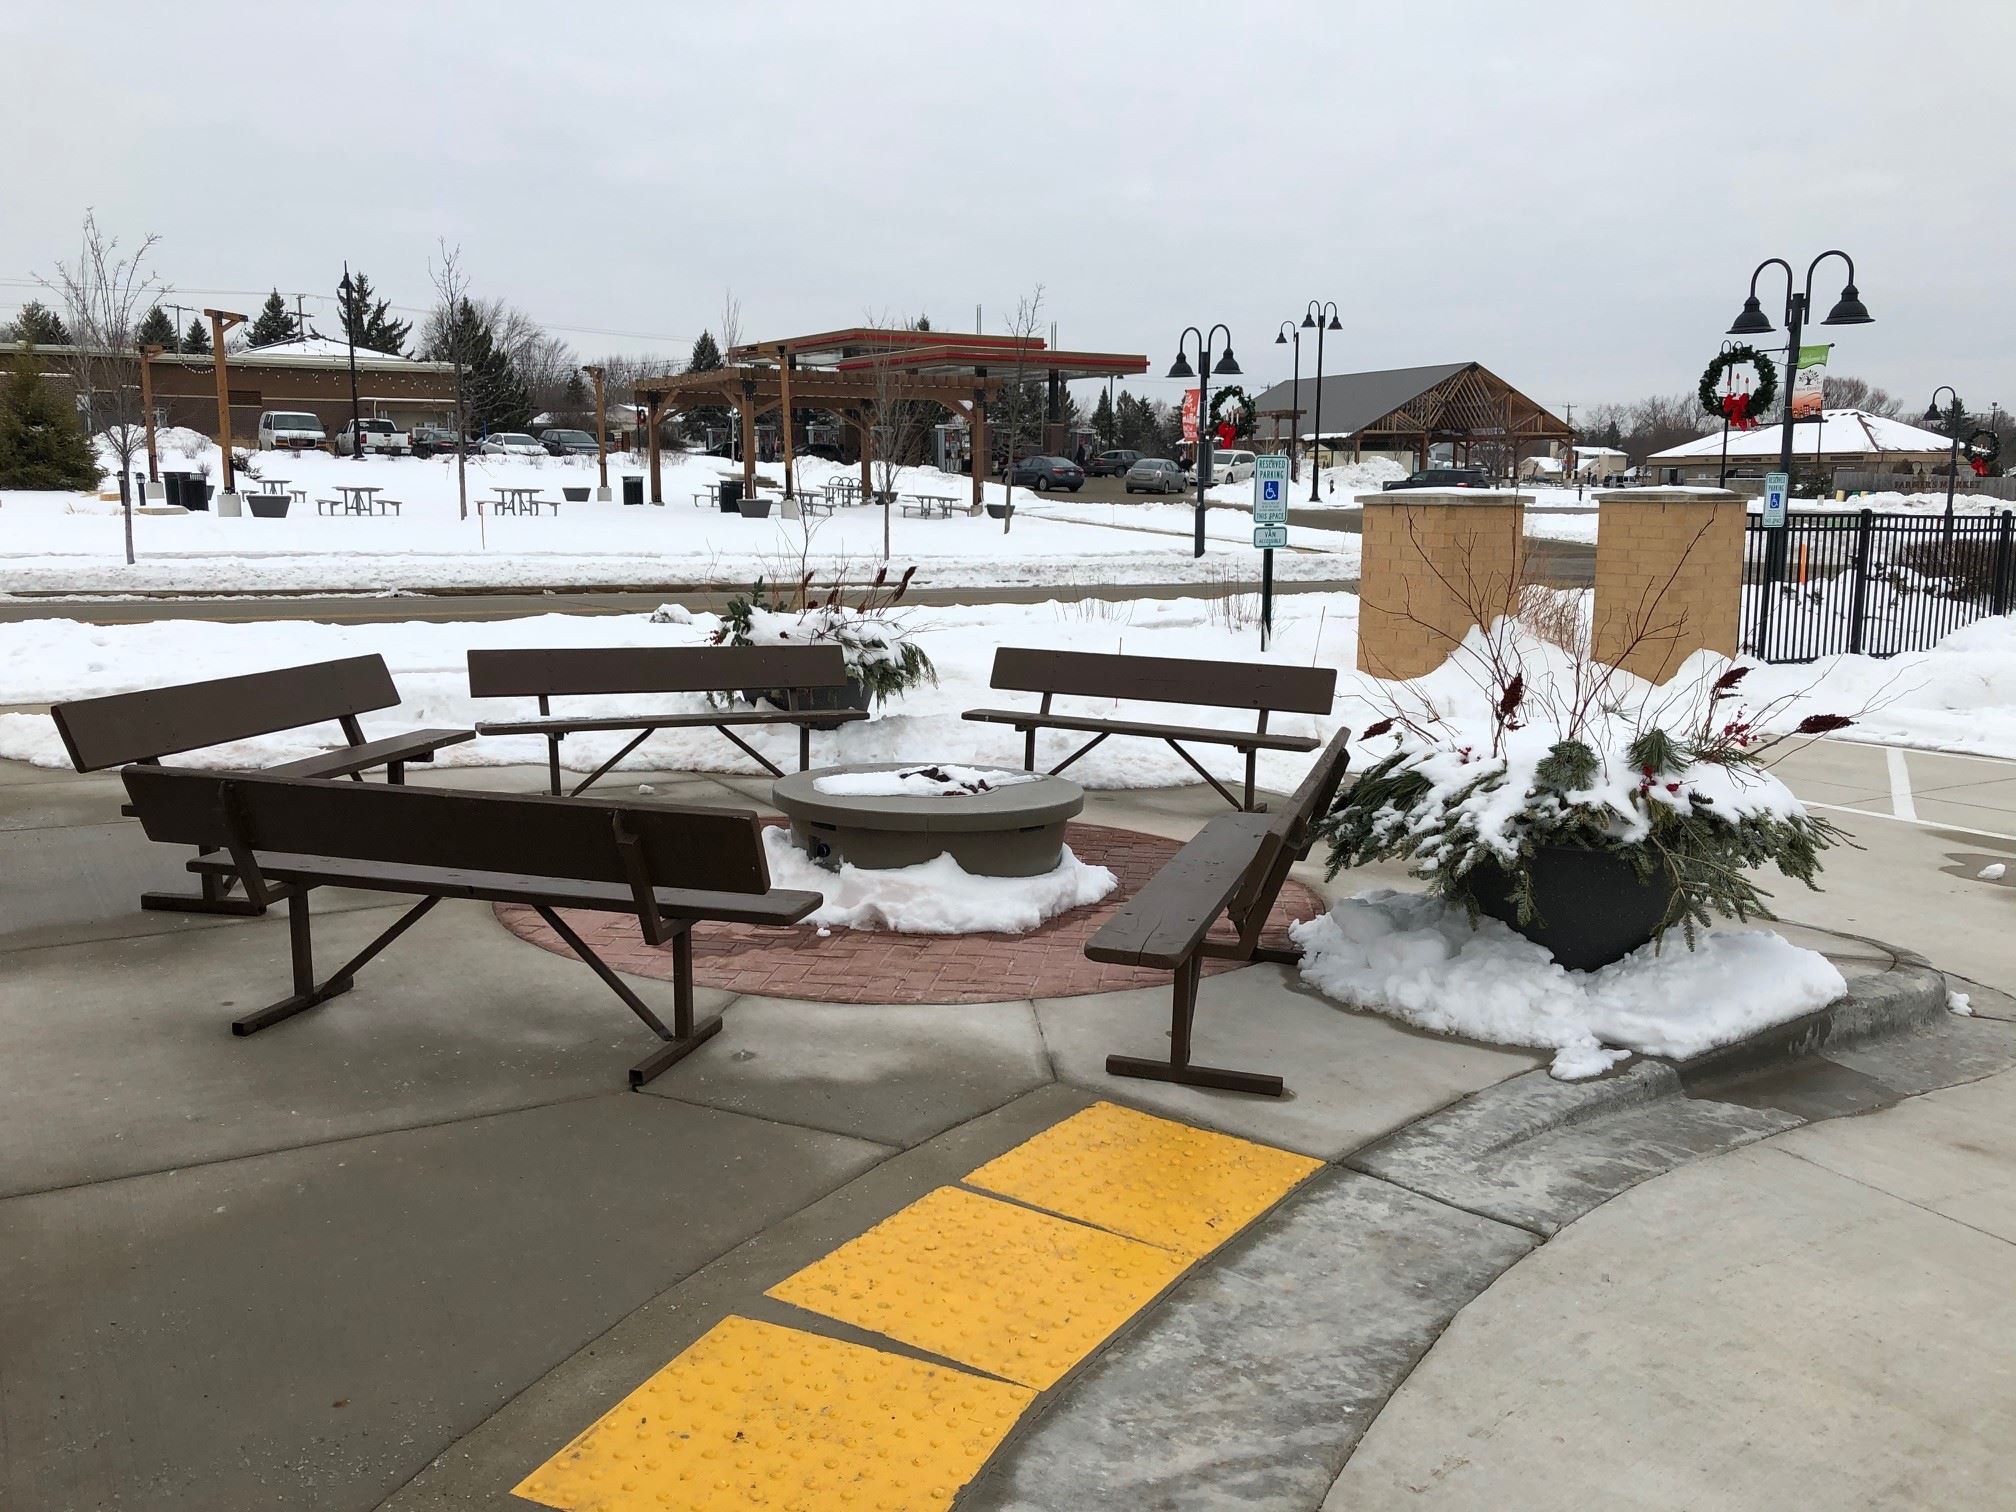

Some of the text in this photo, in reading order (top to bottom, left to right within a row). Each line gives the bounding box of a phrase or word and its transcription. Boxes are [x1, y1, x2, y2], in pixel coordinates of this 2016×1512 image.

[1259, 460, 1286, 469] RESERVED
[1260, 471, 1284, 479] PARKING
[1940, 481, 1981, 489] MRKET
[1257, 512, 1284, 520] THIS SPACE
